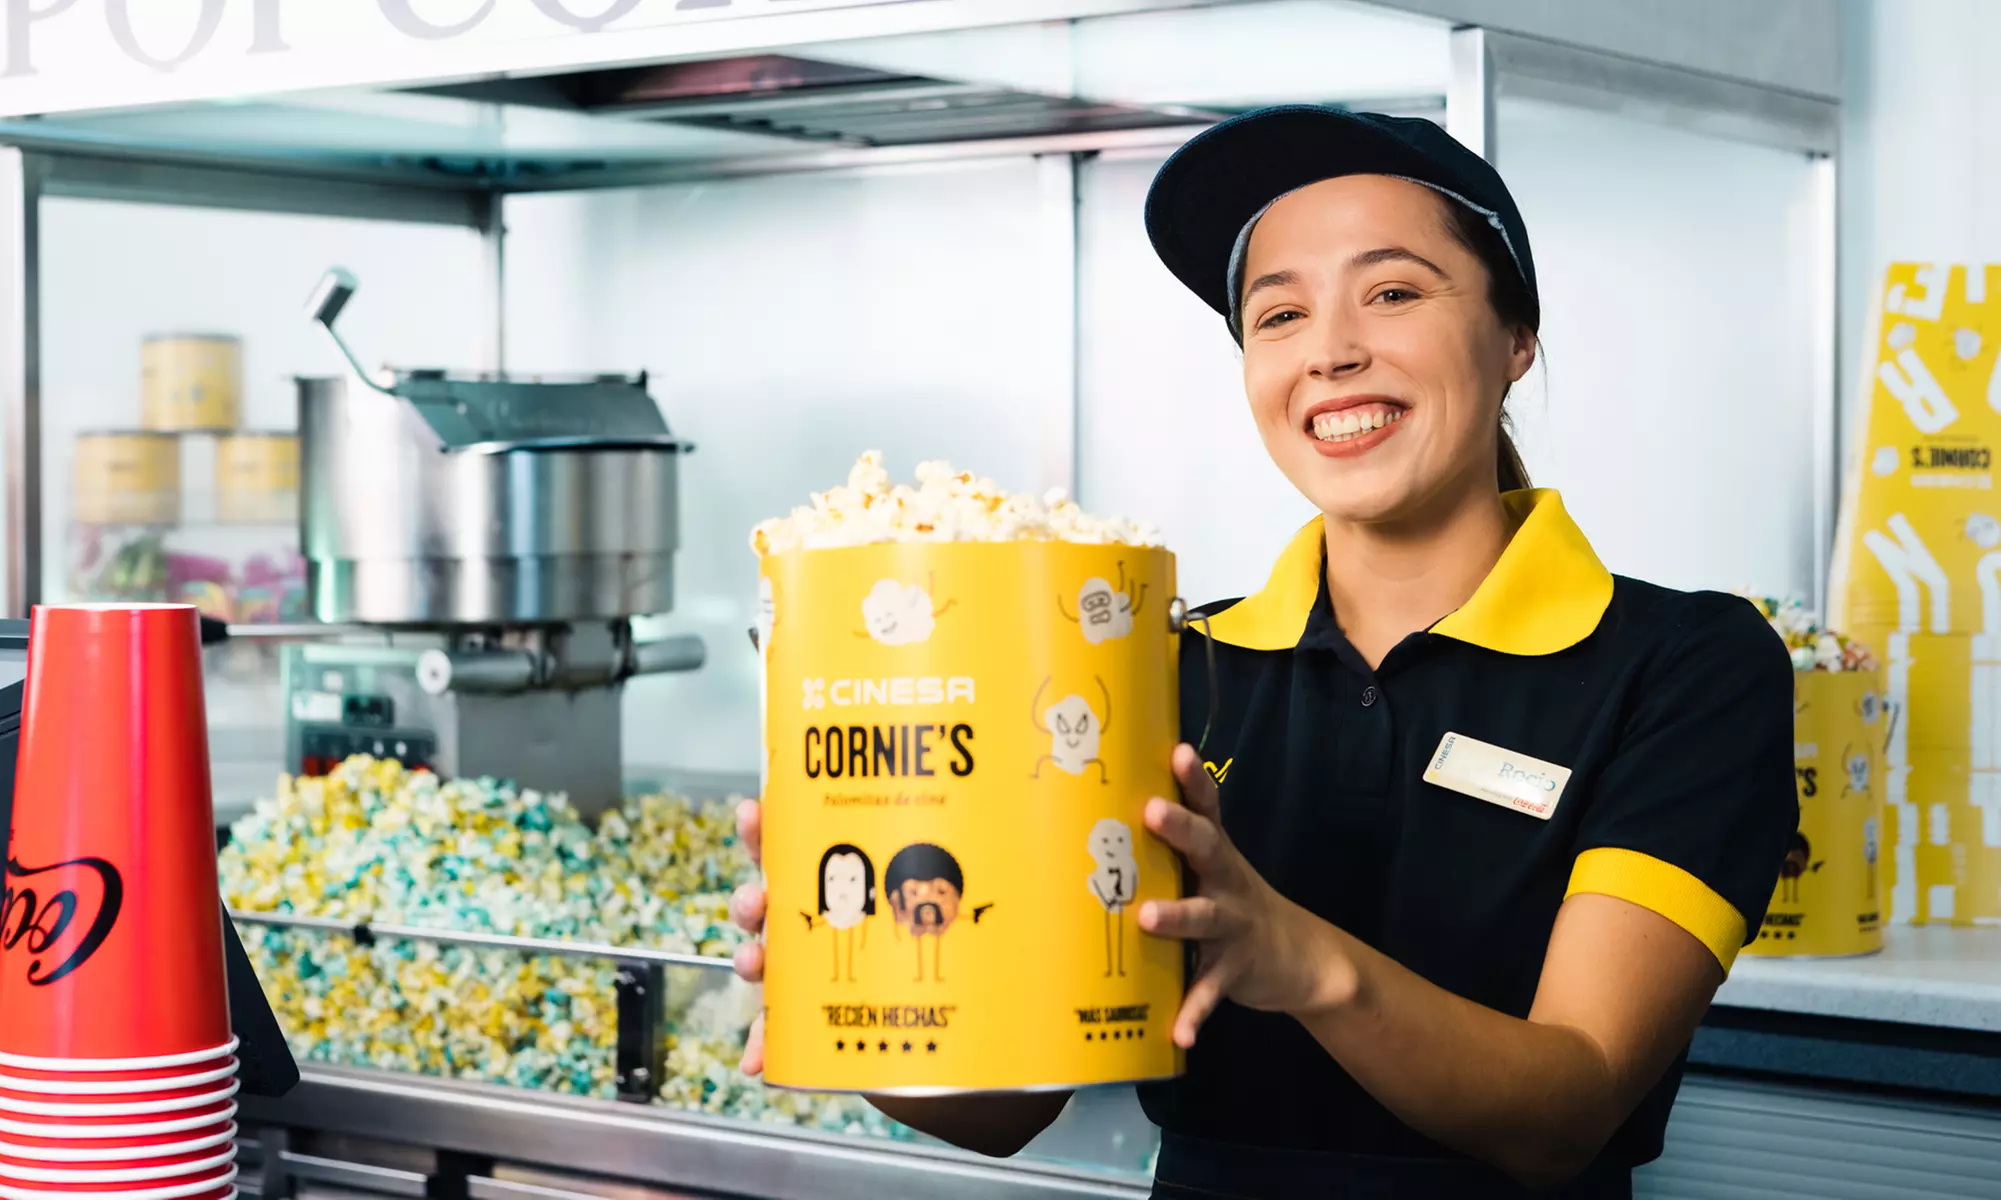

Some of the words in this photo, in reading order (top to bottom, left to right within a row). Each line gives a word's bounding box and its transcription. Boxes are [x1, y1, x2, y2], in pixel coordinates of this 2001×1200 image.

[830, 676, 975, 706] CINESA
[804, 723, 975, 778] CORNIE'S
[1434, 736, 1456, 770] CINESA
